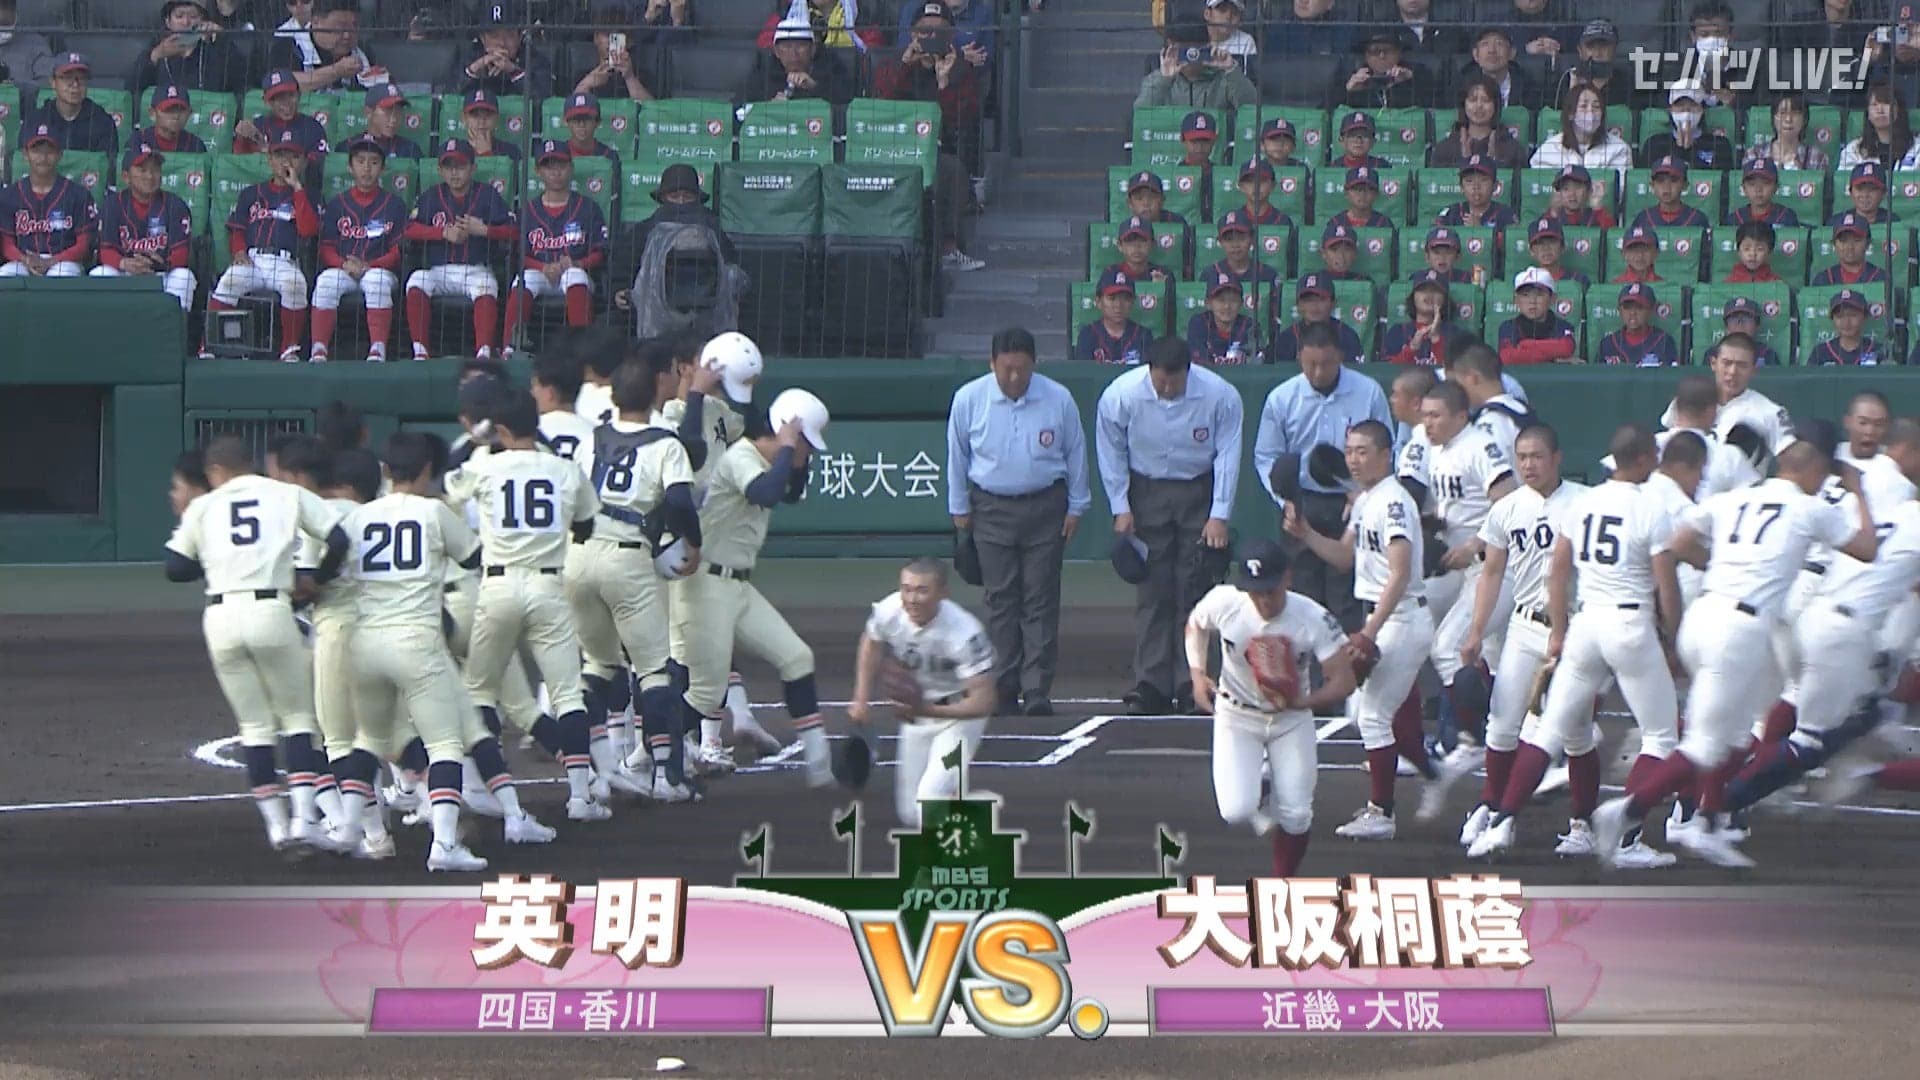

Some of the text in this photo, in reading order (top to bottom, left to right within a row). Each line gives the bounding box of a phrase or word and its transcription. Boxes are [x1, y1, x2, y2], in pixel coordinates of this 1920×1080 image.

[230, 499, 261, 546] 5
[501, 479, 554, 529] 16
[1728, 502, 1787, 544] 17
[362, 520, 423, 572] 20
[1579, 513, 1624, 566] 15
